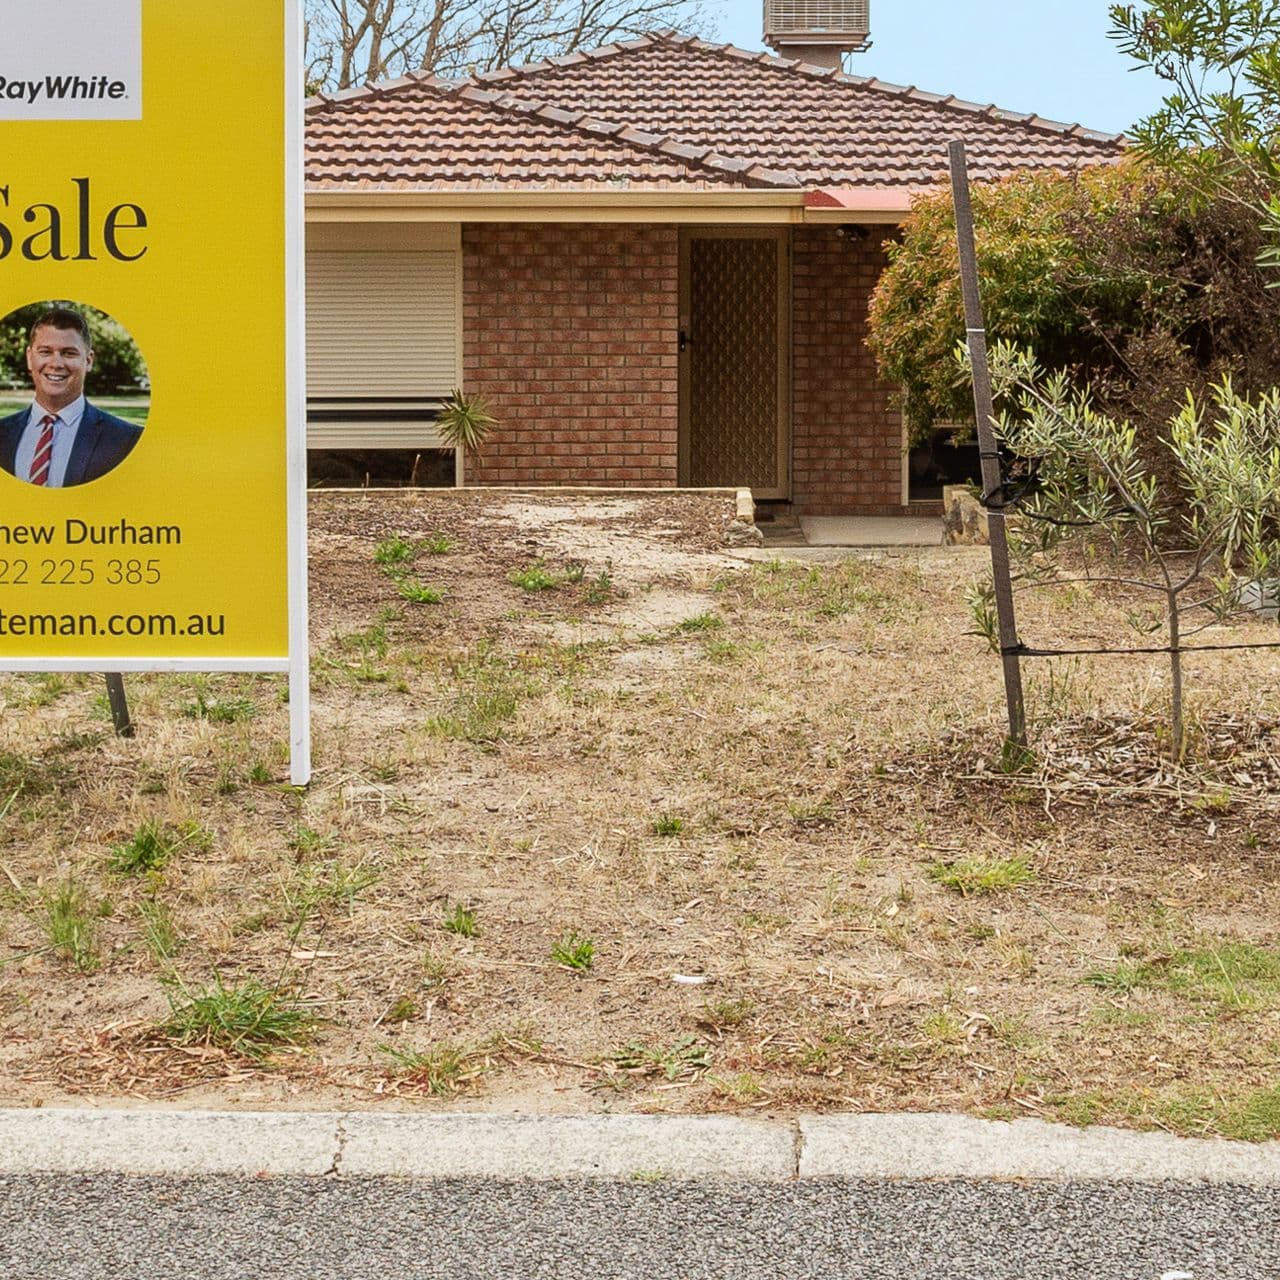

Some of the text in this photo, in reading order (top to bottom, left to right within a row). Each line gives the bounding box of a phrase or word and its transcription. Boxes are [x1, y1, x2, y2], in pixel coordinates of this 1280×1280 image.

[64, 517, 182, 546] Durham
[39, 558, 95, 585] 225
[105, 558, 161, 585] 385
